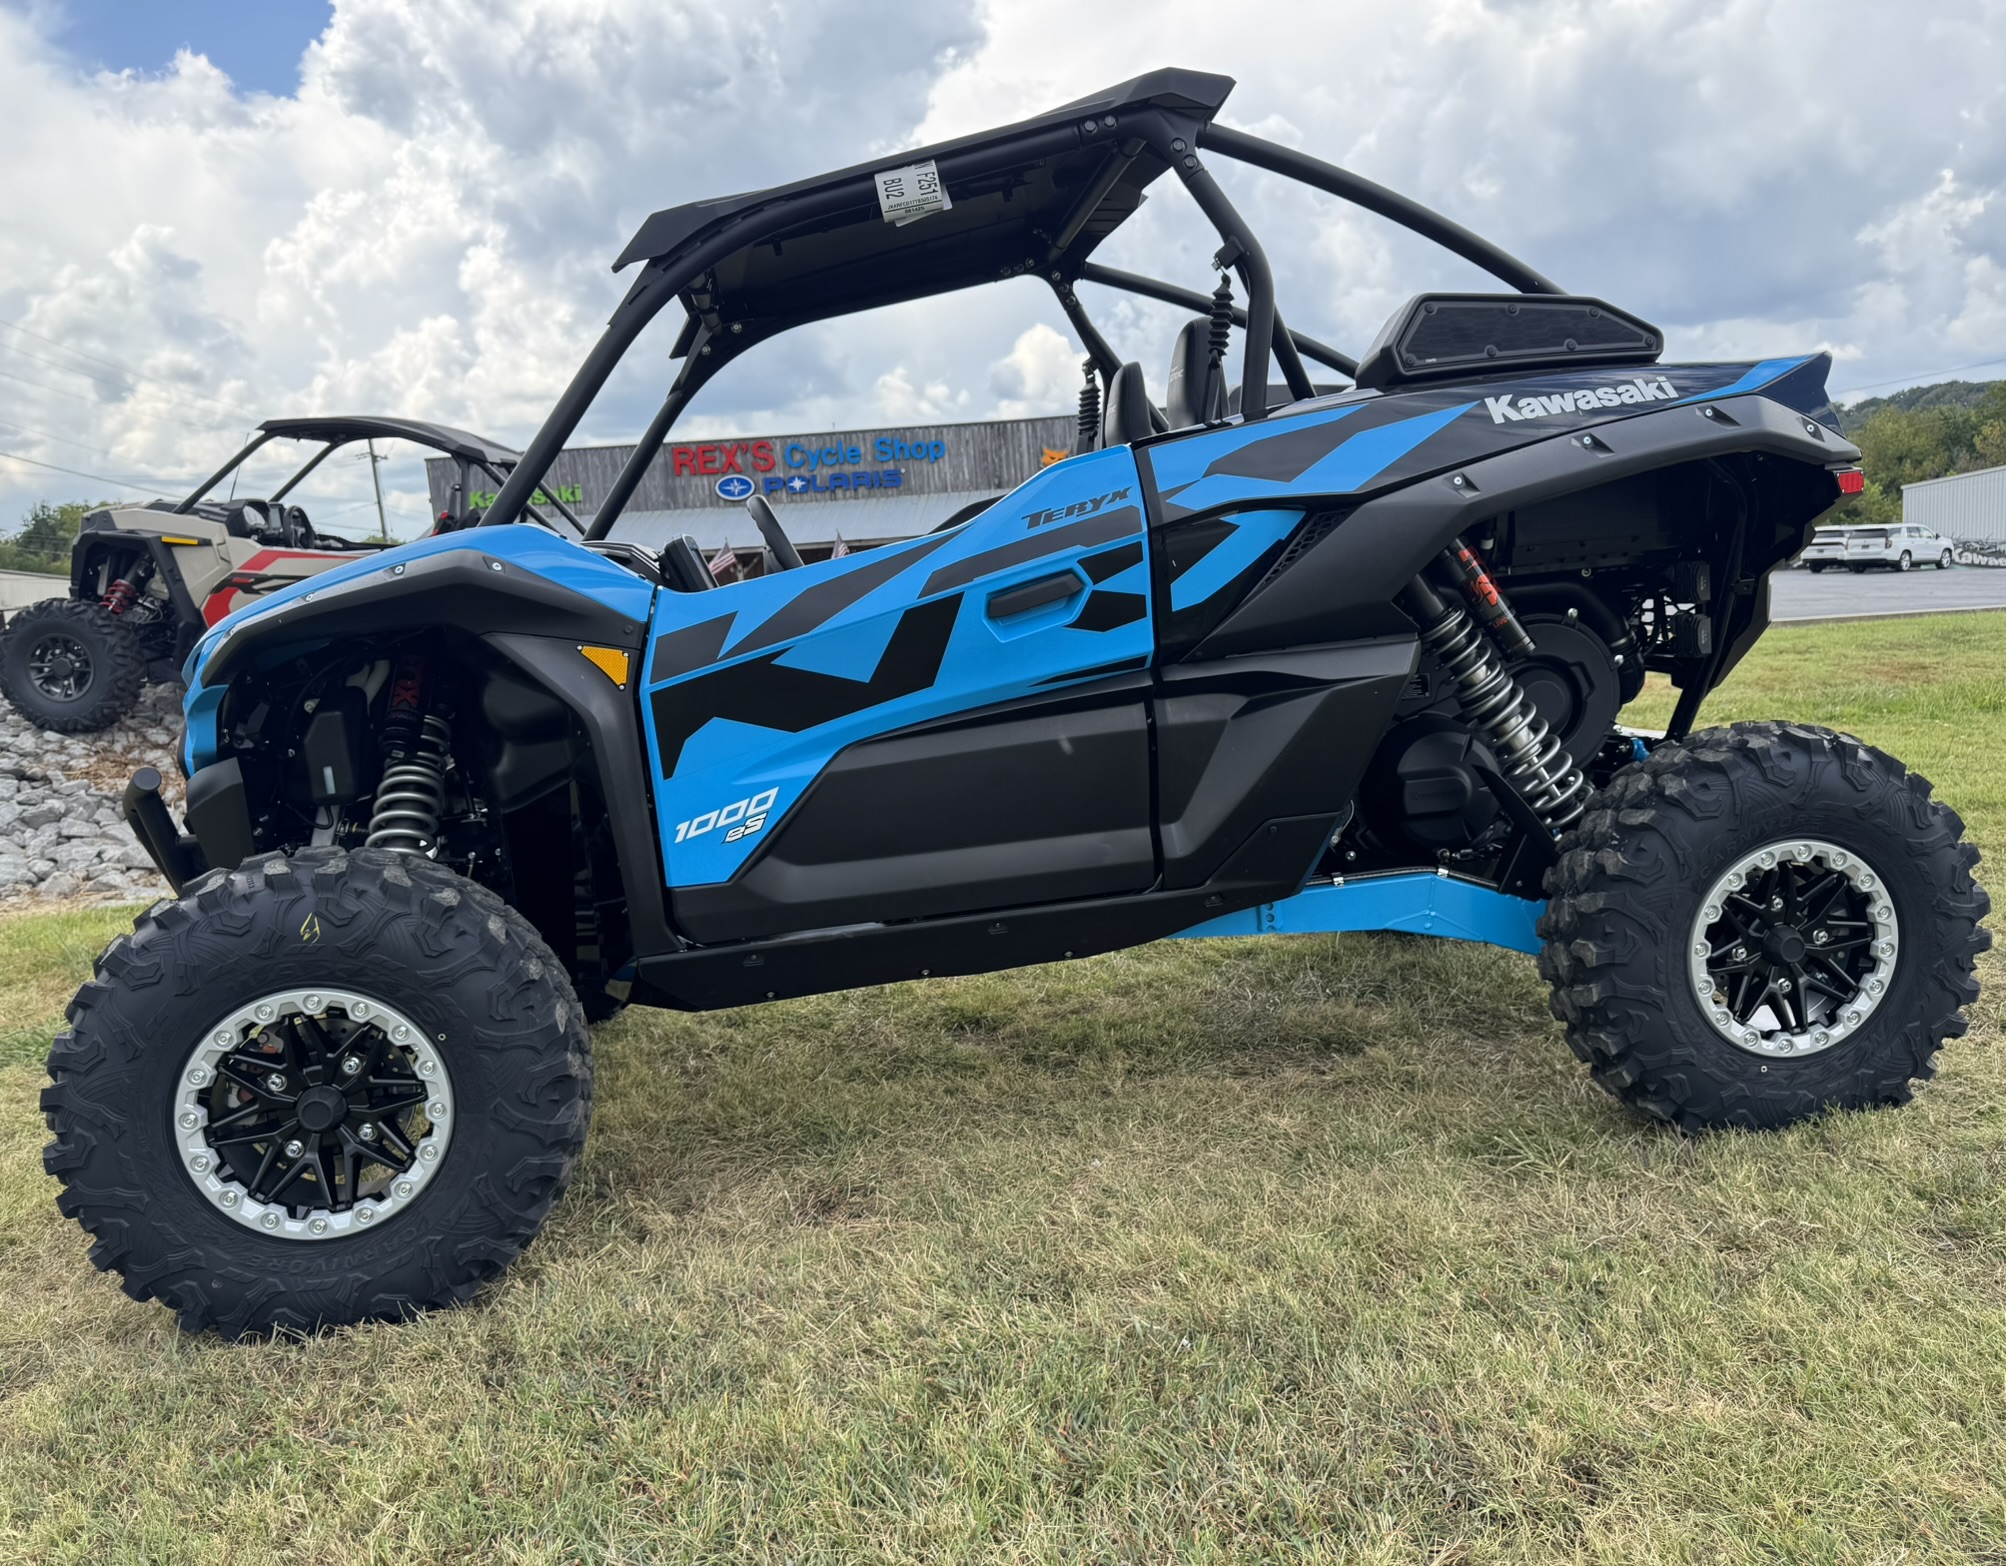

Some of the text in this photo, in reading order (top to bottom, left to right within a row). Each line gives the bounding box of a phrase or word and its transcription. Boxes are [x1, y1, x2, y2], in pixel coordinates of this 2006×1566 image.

[883, 177, 905, 200] BU2
[916, 171, 939, 196] F251
[1484, 376, 1679, 424] Kawasaki
[672, 437, 945, 476] REX'S Cycle Shop
[763, 469, 903, 496] POLARIS
[674, 786, 780, 844] 1000
